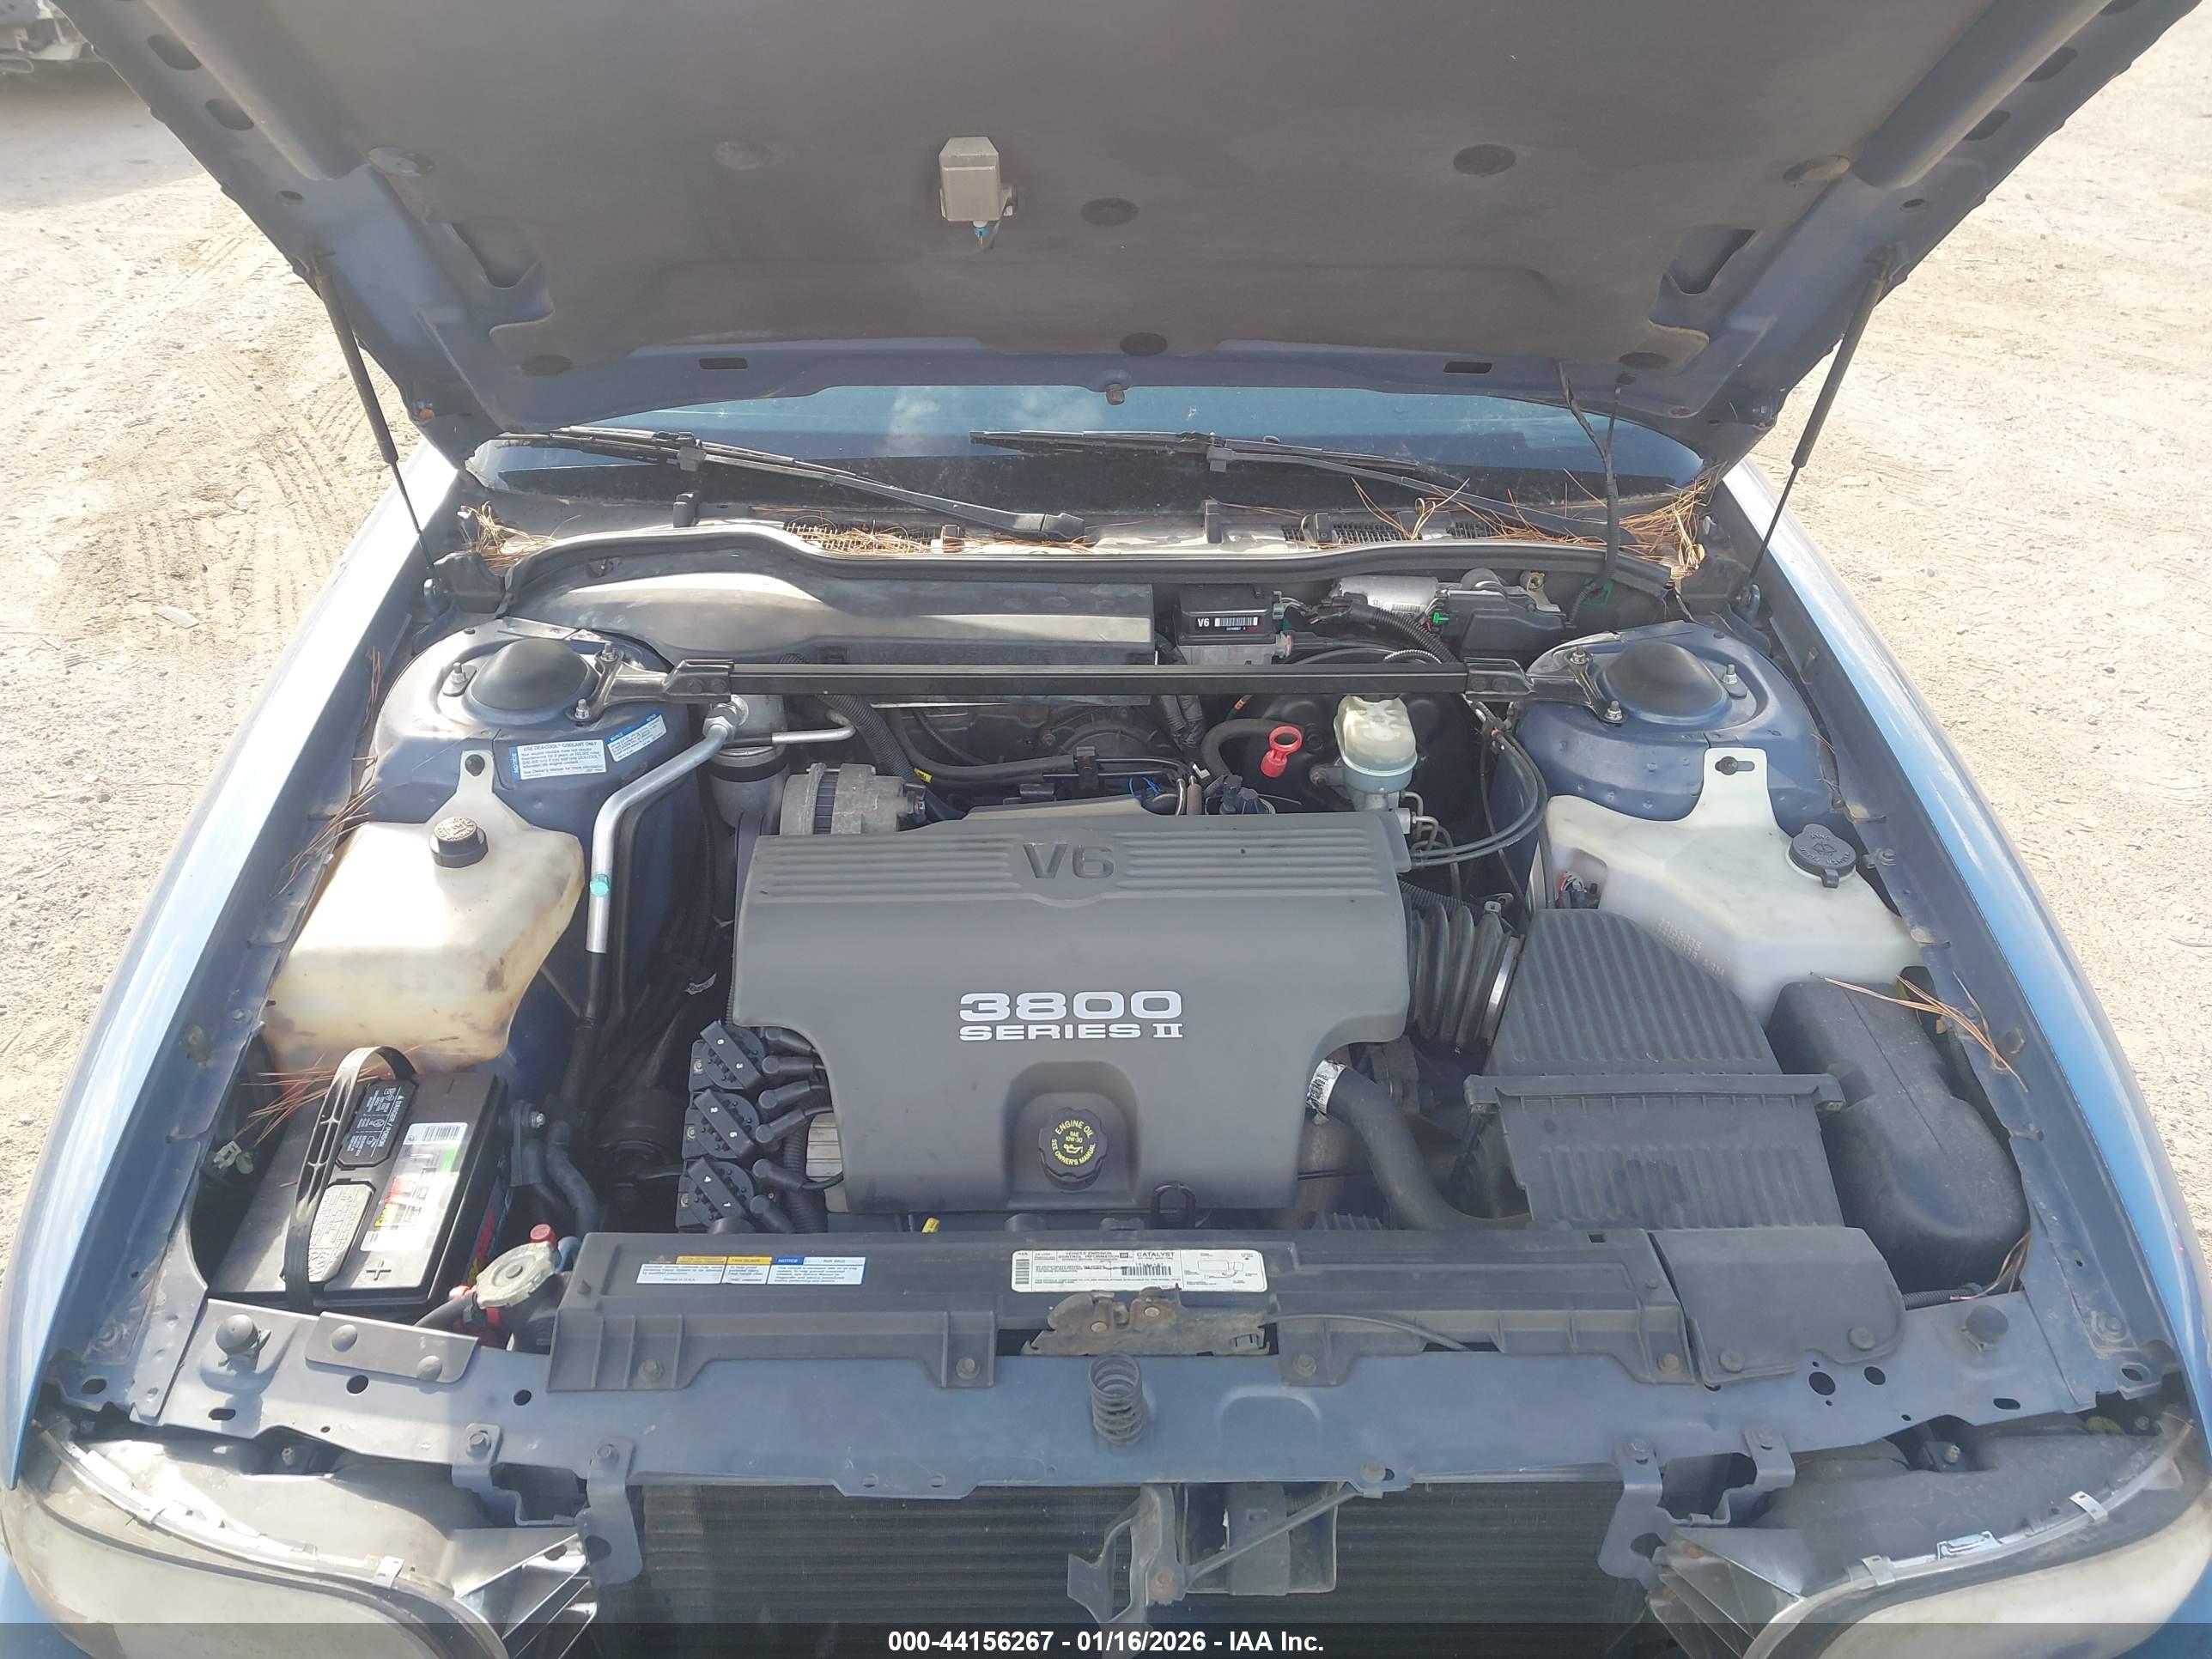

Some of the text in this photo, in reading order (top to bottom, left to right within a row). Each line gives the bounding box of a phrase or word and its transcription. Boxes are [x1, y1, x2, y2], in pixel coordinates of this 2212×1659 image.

[1197, 618, 1210, 627] V6
[1023, 842, 1115, 880] V6
[958, 989, 1183, 1022] 3800
[959, 1023, 1183, 1042] SERIES II
[388, 1100, 402, 1122] DANGER
[377, 1127, 392, 1147] POISON
[1054, 1119, 1095, 1139] ENGINE OIL
[1054, 1151, 1079, 1166] OWNER'S
[1079, 1143, 1097, 1164] MANUAL
